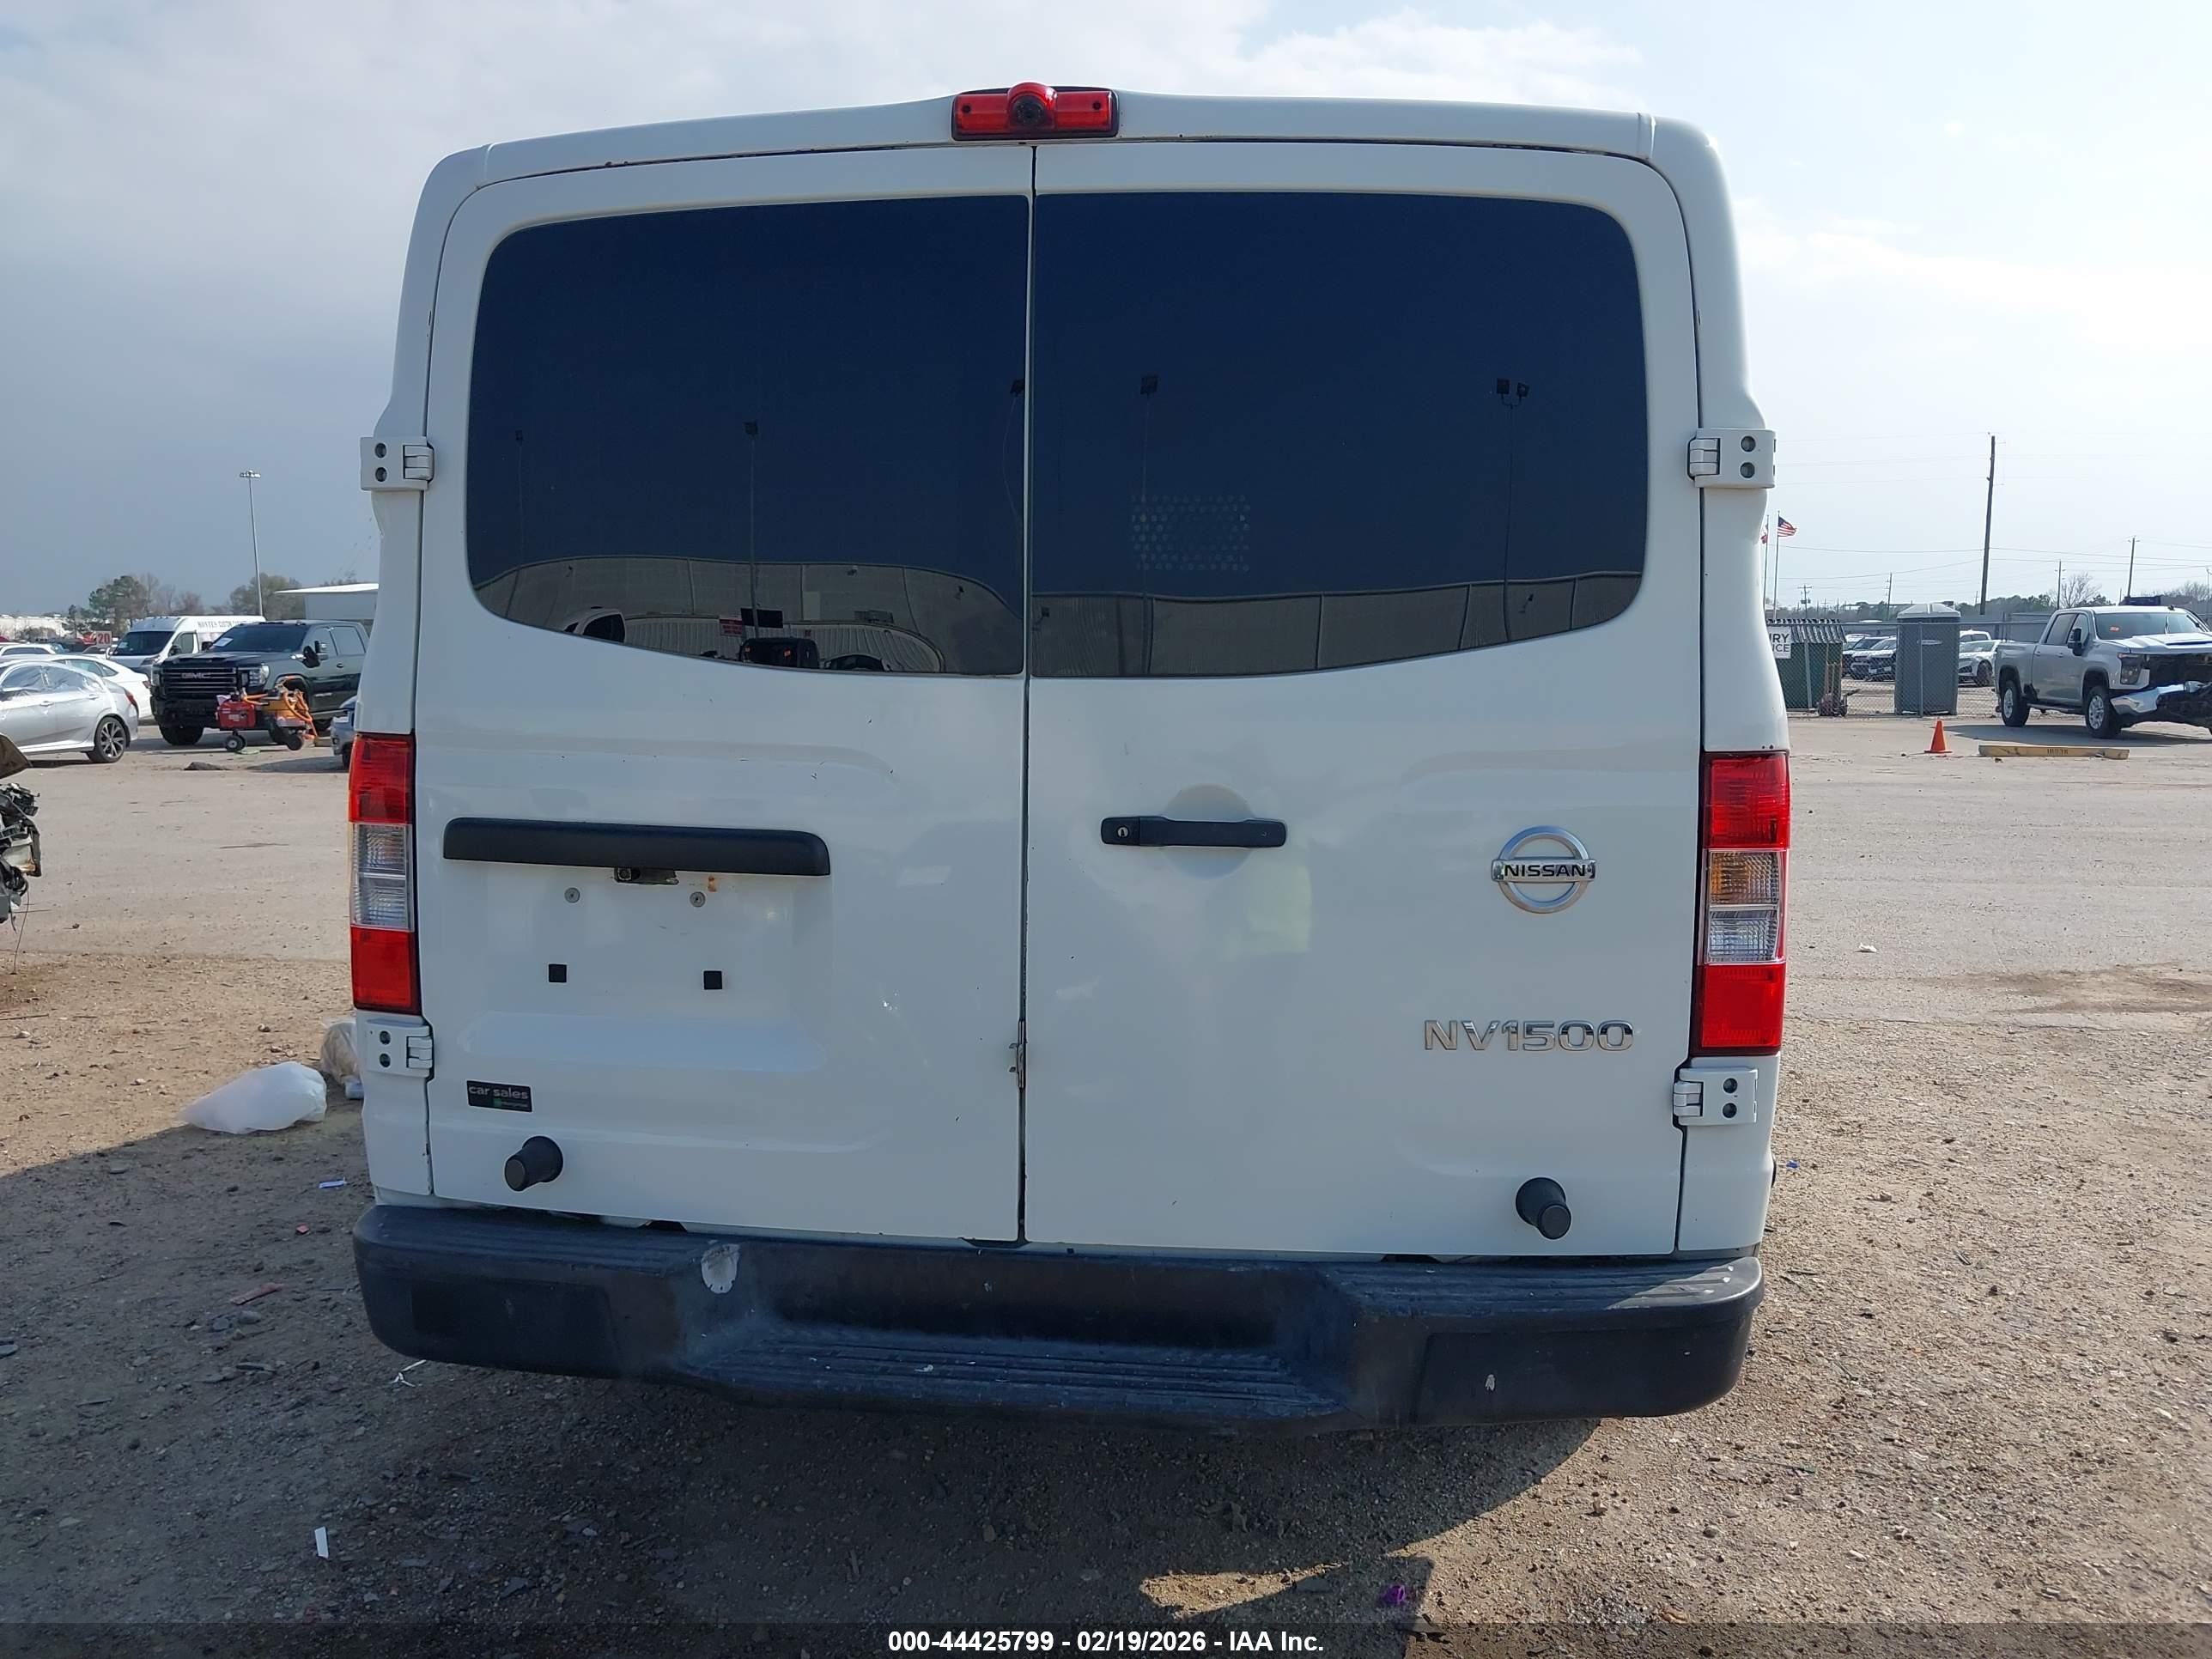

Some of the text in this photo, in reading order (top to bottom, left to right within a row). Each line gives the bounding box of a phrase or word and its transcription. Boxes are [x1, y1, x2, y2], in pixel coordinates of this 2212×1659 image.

[97, 633, 111, 645] 20
[1504, 864, 1587, 878] NISSAN
[1424, 1019, 1634, 1052] NV1500
[468, 1086, 528, 1099] car sales
